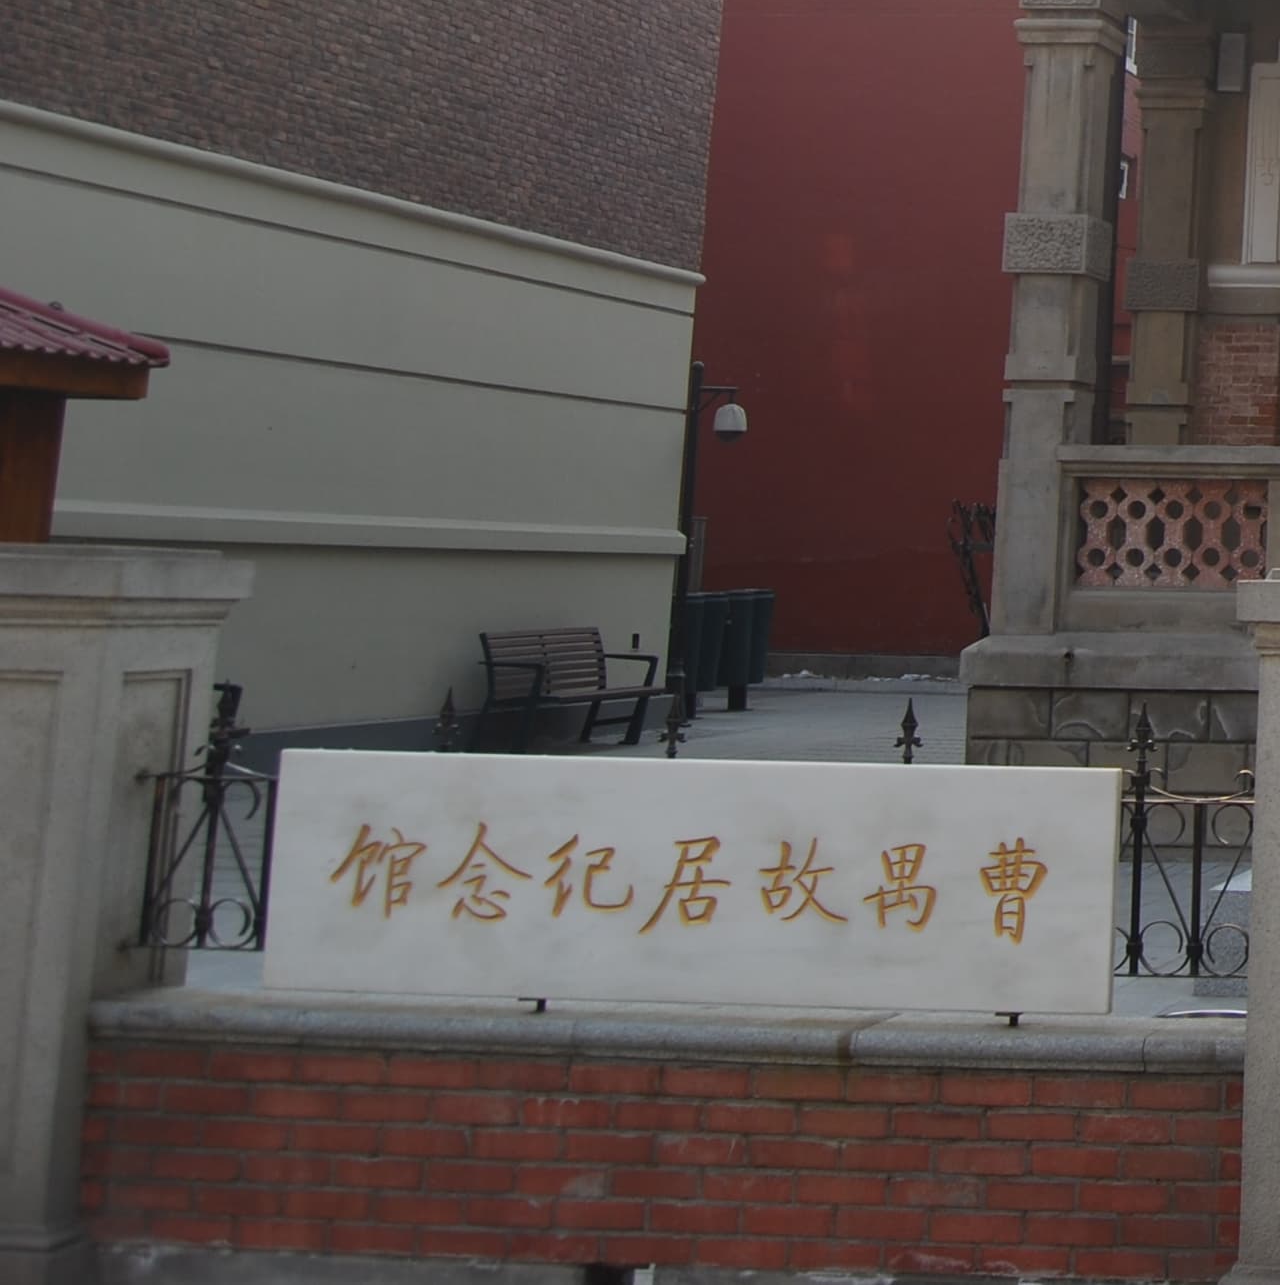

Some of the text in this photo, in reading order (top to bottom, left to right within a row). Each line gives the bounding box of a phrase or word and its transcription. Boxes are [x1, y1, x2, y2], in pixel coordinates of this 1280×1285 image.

[329, 821, 1049, 945] 曹禺故居纪念馆
